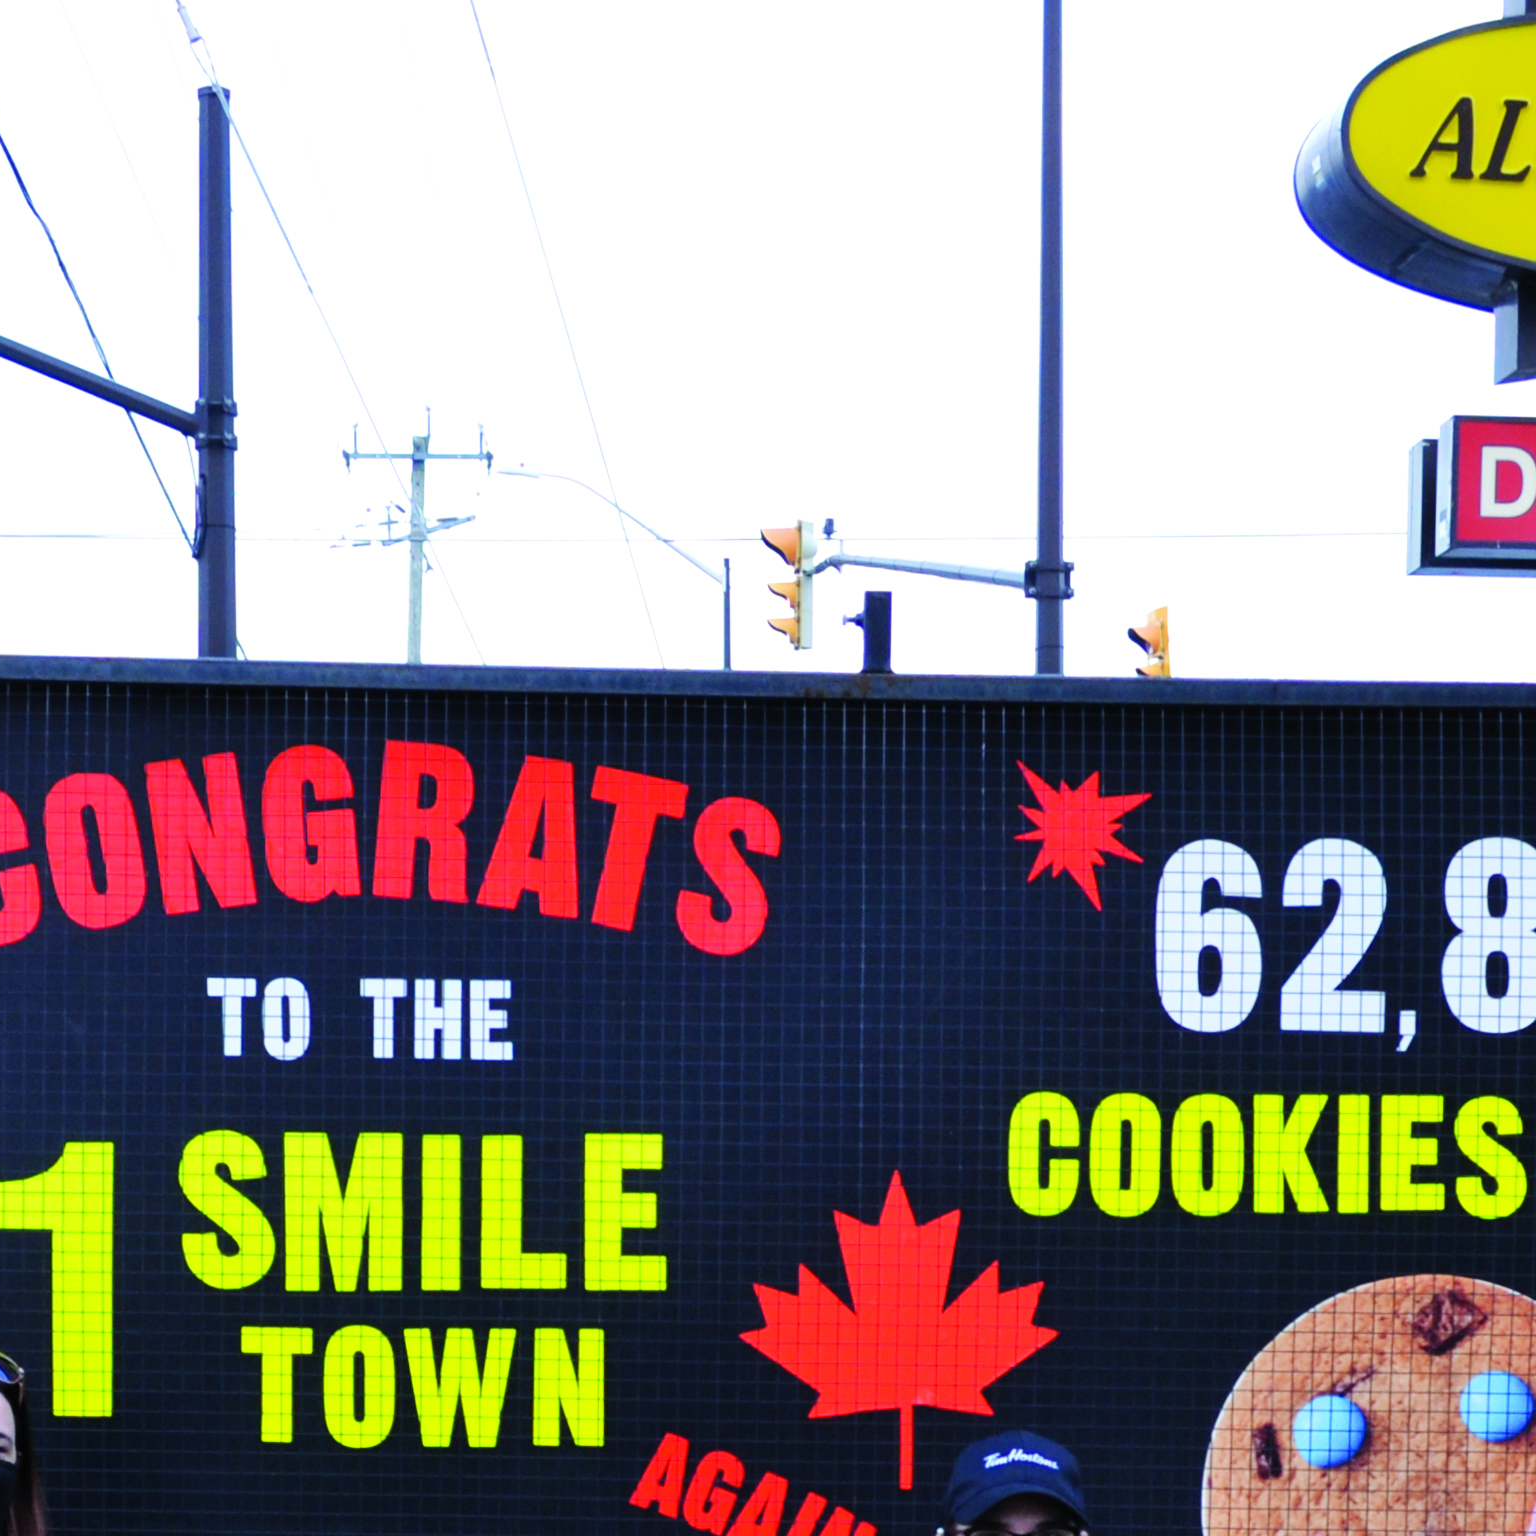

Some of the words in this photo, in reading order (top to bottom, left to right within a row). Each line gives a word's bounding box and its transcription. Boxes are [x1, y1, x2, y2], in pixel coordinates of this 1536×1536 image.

[206, 977, 311, 1061] TO
[360, 978, 514, 1061] THE
[178, 1130, 668, 1292] SMILE
[1007, 1091, 1528, 1219] COOKIES
[241, 1325, 605, 1449] TOWN
